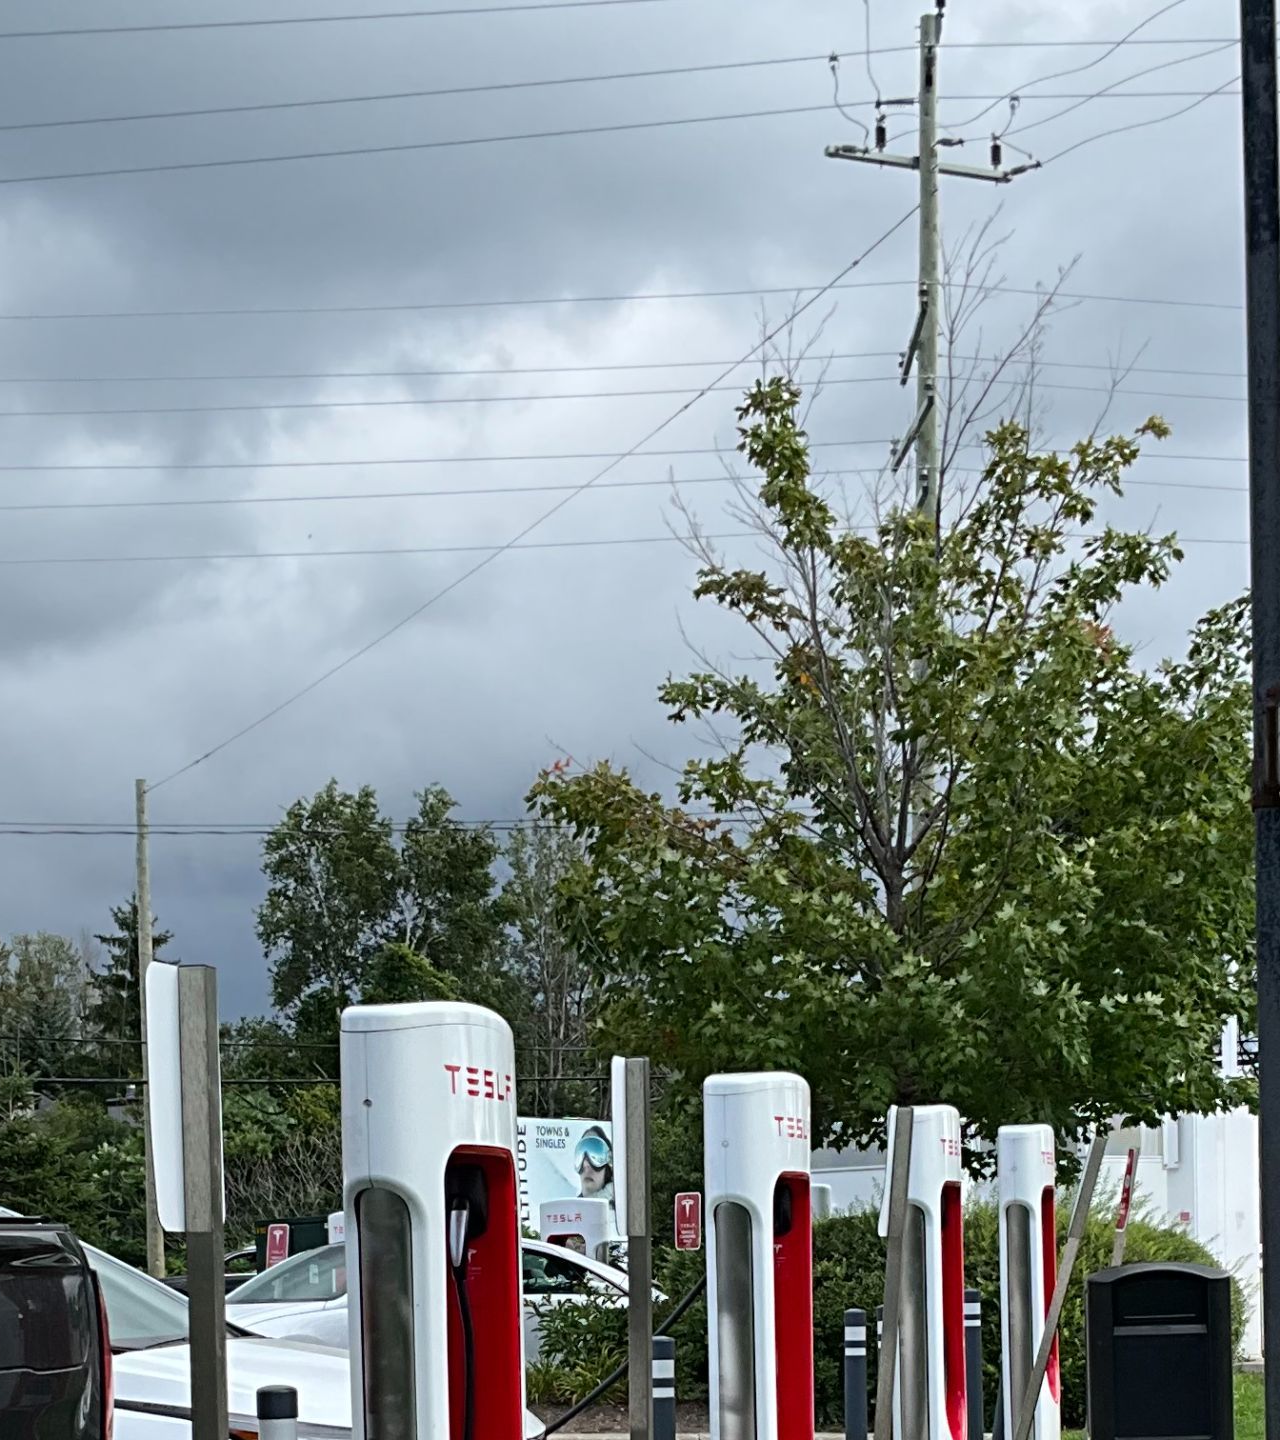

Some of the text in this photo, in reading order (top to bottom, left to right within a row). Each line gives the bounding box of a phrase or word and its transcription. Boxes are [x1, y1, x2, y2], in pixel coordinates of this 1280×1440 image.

[535, 1125, 570, 1137] TOWNS &
[773, 1115, 808, 1140] TESL
[535, 1138, 566, 1149] SINGLES
[517, 1124, 530, 1222] LTITUDE
[545, 1213, 582, 1223] TESLA
